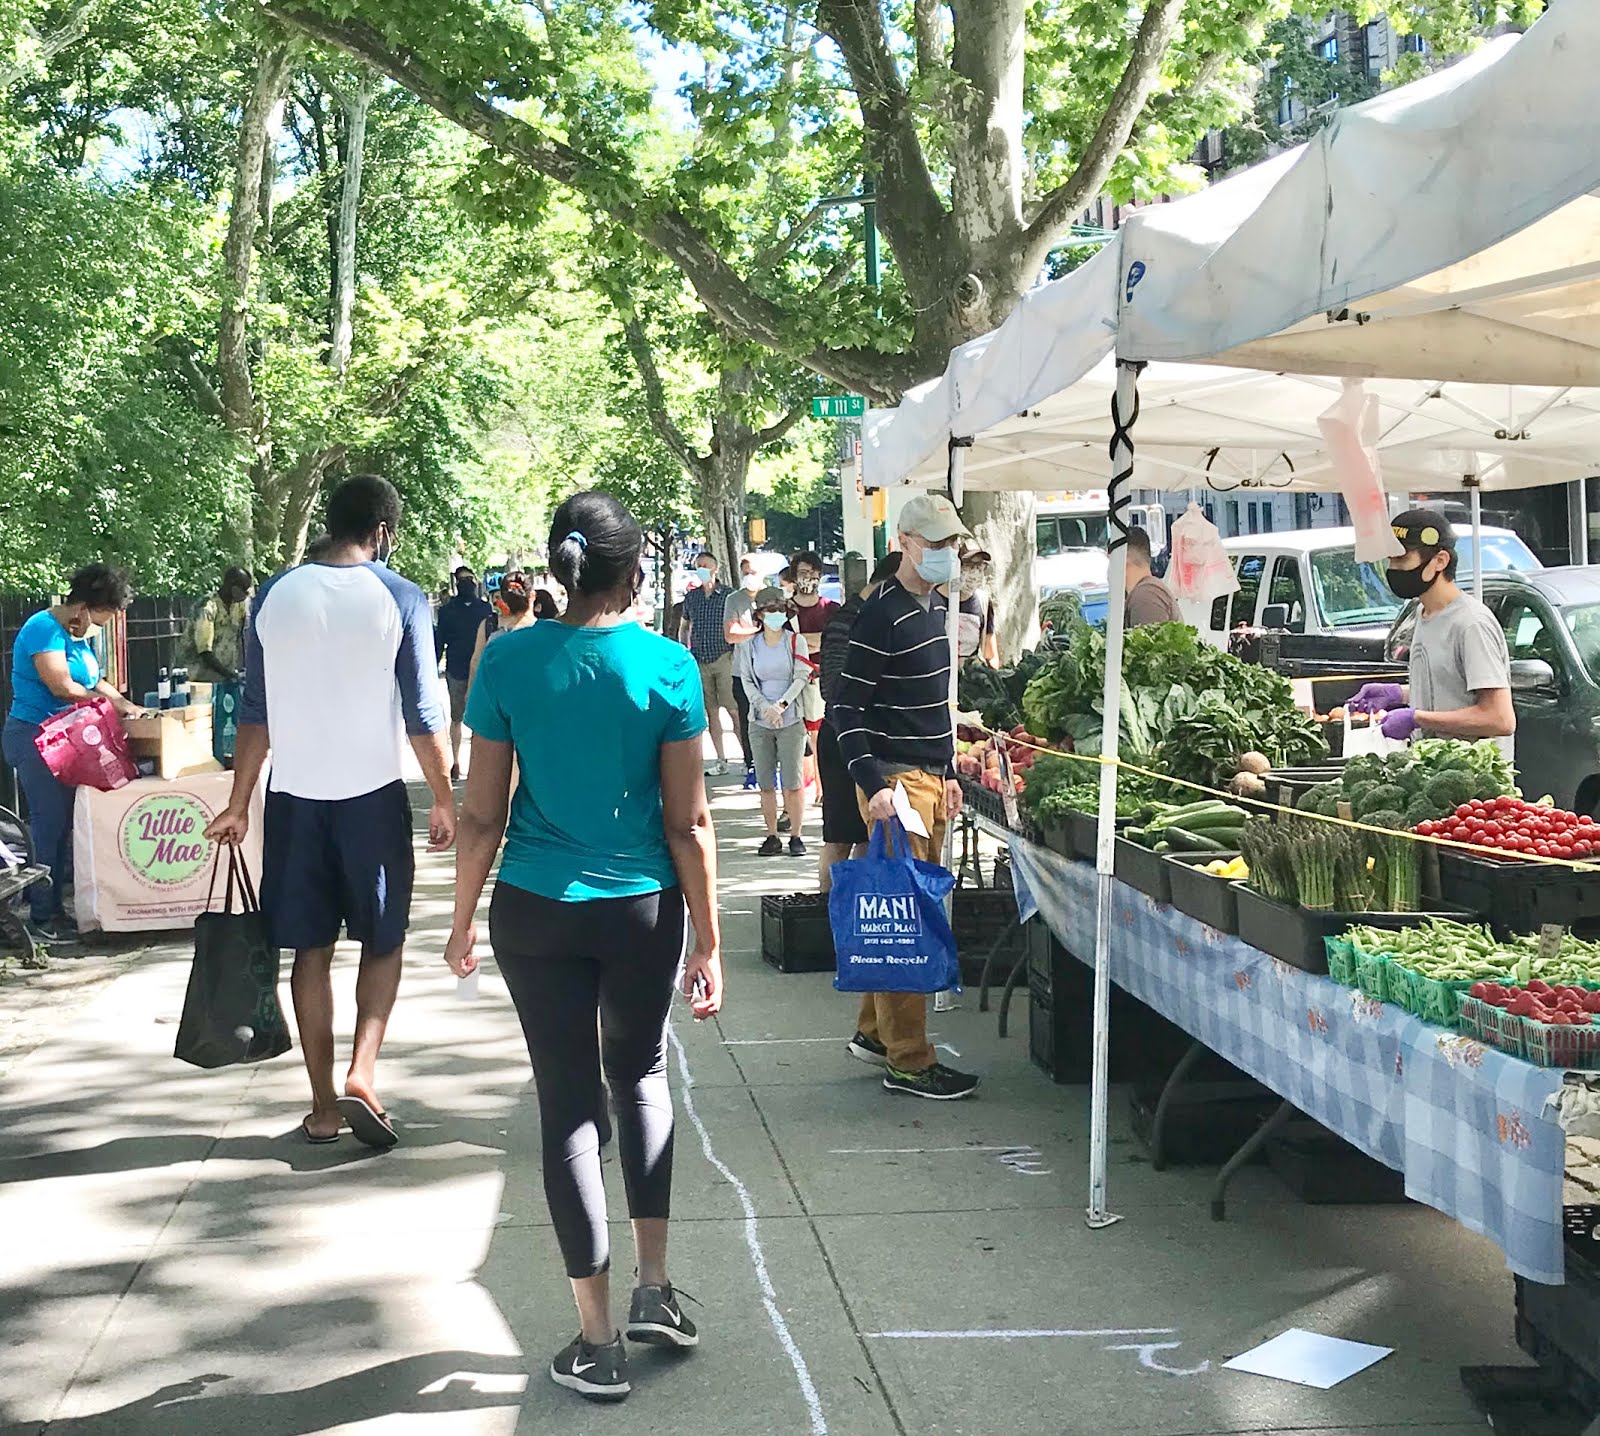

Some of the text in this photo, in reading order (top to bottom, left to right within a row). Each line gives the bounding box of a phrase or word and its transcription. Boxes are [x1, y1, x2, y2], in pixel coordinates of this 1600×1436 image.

[819, 399, 861, 415] W 111 St
[139, 809, 195, 841] Lillie
[145, 838, 203, 868] Mae
[859, 896, 916, 919] MANI
[861, 922, 891, 933] MARKET
[850, 955, 884, 964] Please
